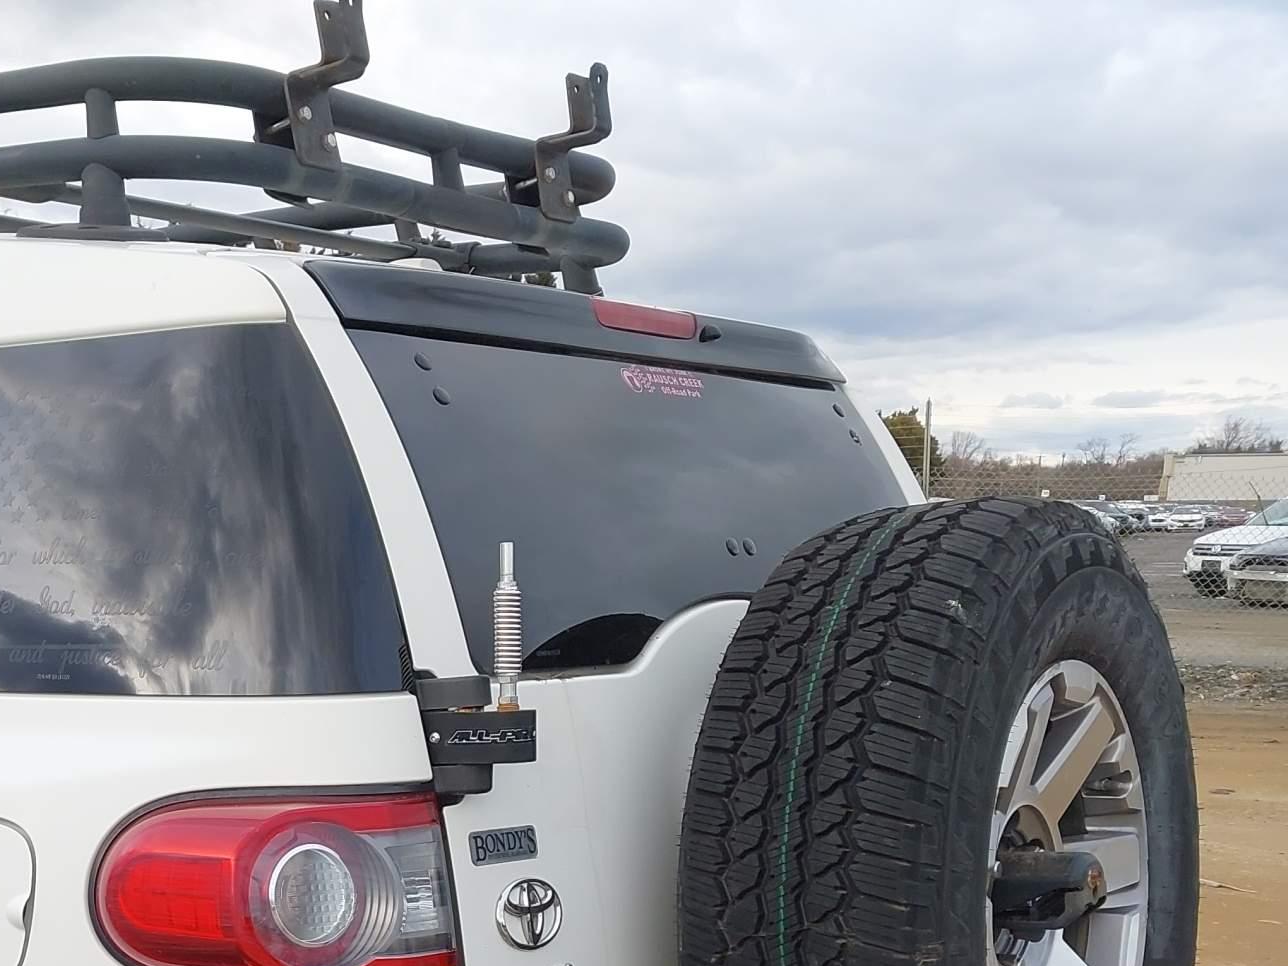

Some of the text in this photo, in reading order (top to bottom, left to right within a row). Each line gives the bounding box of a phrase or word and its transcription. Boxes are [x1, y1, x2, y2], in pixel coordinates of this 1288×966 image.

[679, 376, 705, 389] CREEK
[31, 536, 89, 566] which
[8, 639, 48, 665] and
[58, 643, 122, 673] justice
[191, 640, 228, 672] all
[472, 827, 537, 862] BONDY'S
